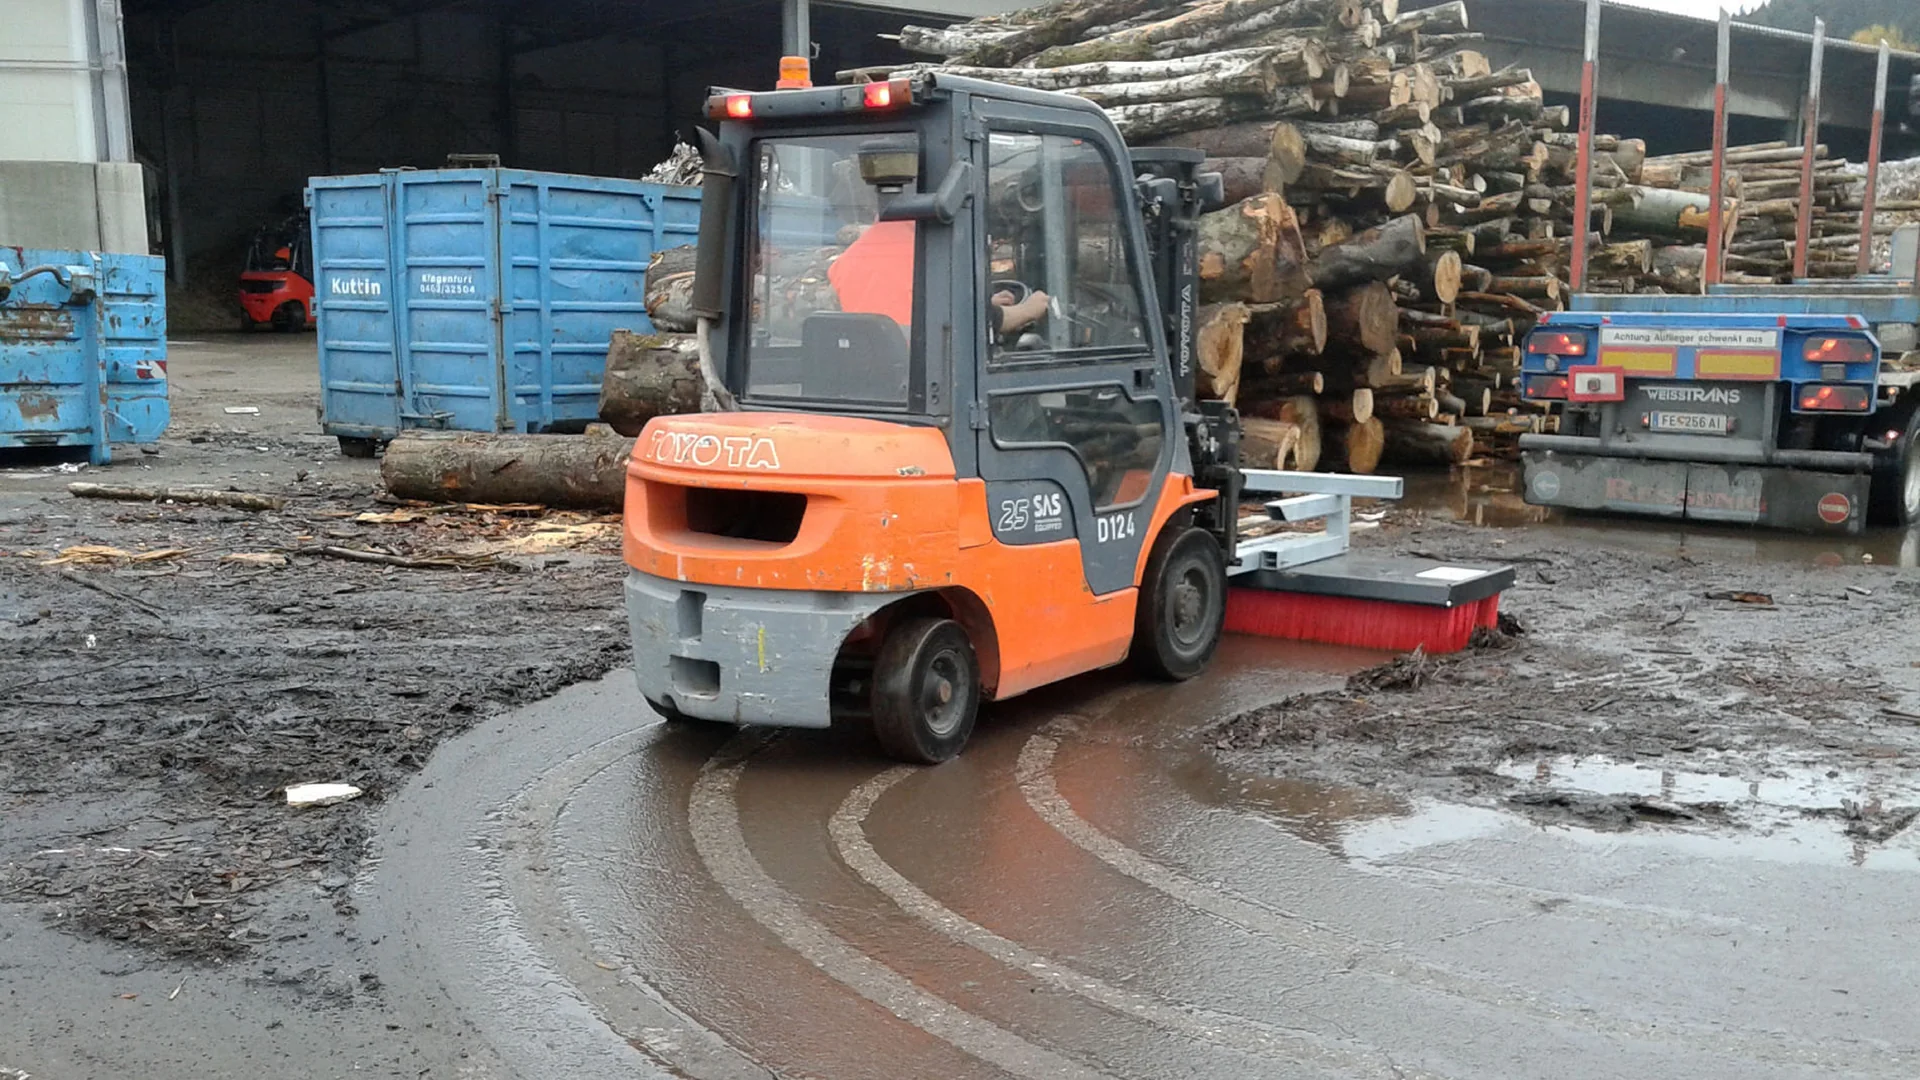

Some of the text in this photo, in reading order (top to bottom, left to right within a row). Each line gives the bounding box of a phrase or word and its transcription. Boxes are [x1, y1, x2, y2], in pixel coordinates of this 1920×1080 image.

[332, 277, 381, 295] Kuttin
[1180, 284, 1192, 377] TOYOTA
[1613, 332, 1763, 343] Achtung Auflieger schwenkt aus
[646, 430, 780, 469] TOYOTA
[997, 499, 1029, 532] 25
[1033, 493, 1062, 518] SAS
[1097, 511, 1136, 543] D124
